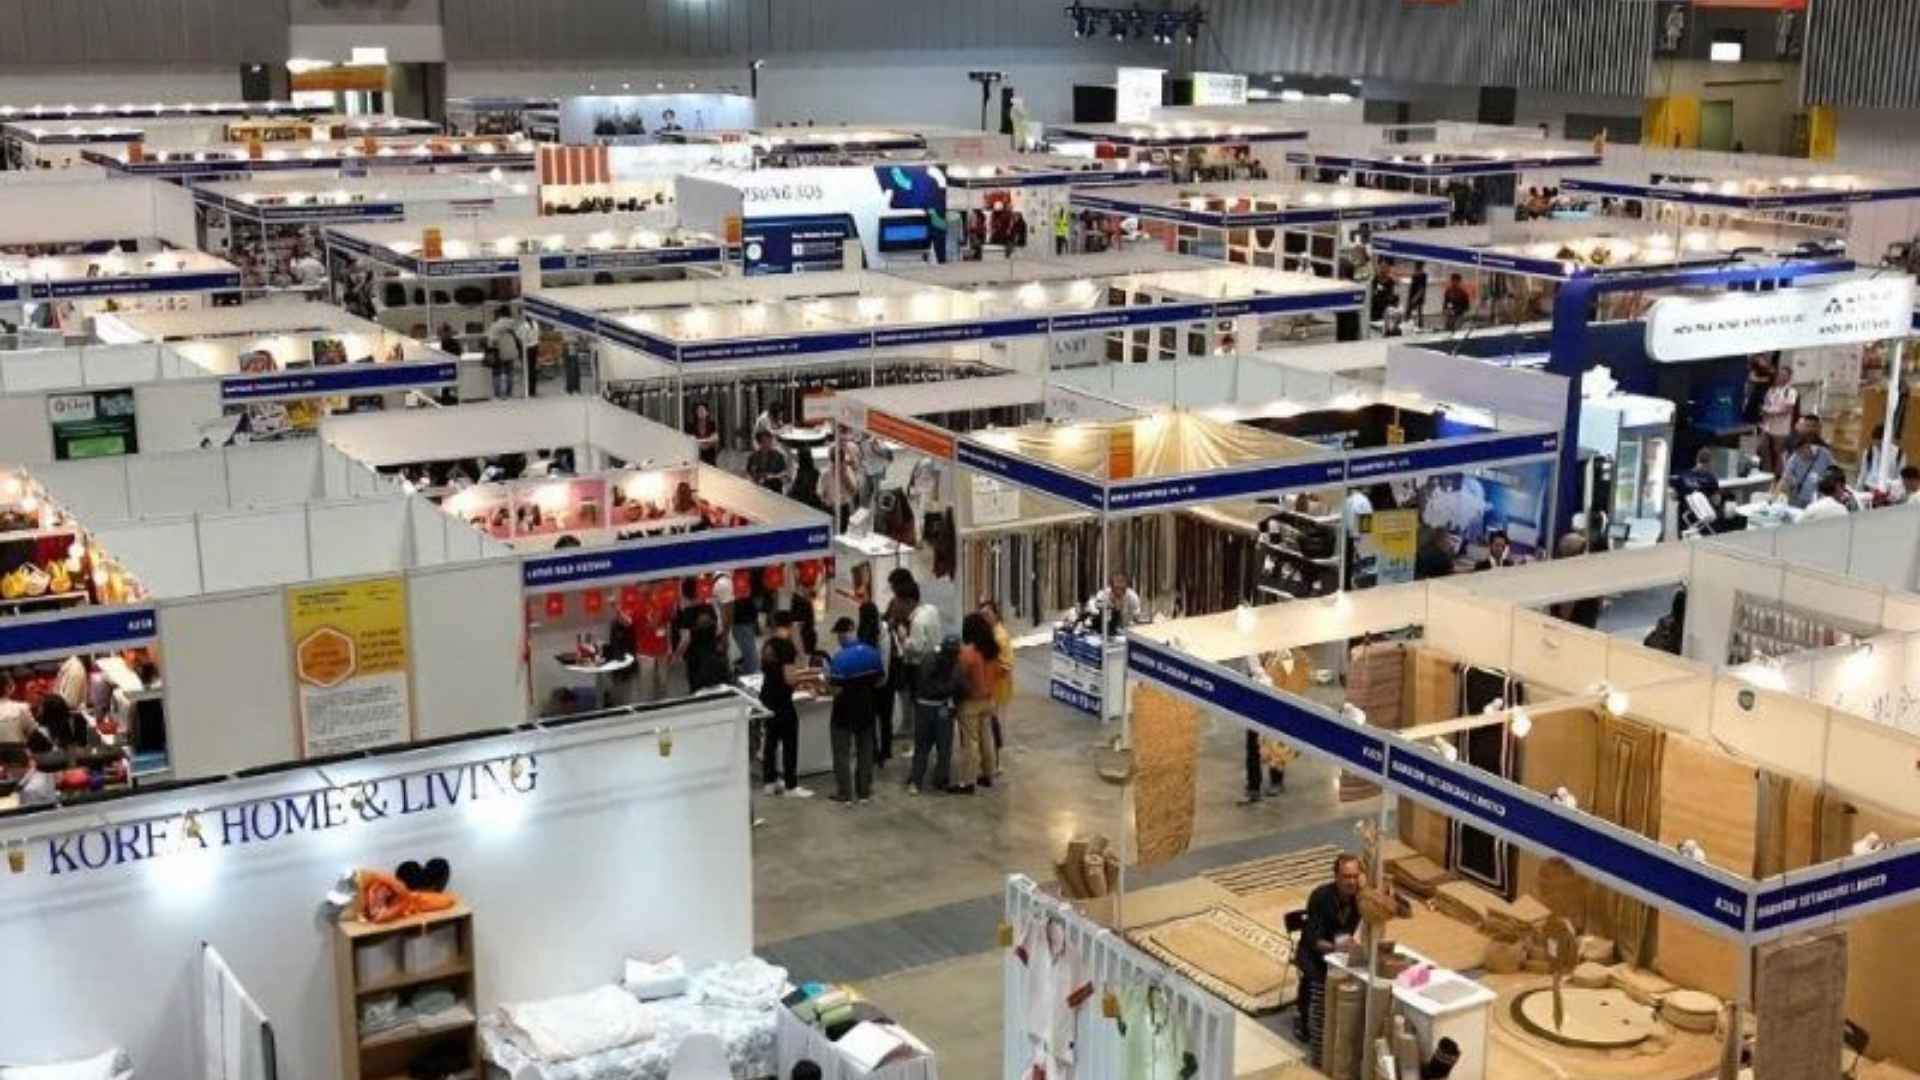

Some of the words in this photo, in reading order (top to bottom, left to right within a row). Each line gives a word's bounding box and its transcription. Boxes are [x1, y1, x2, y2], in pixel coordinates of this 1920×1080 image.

[222, 787, 348, 846] HOME
[359, 780, 388, 821] &
[400, 753, 538, 815] LIVING
